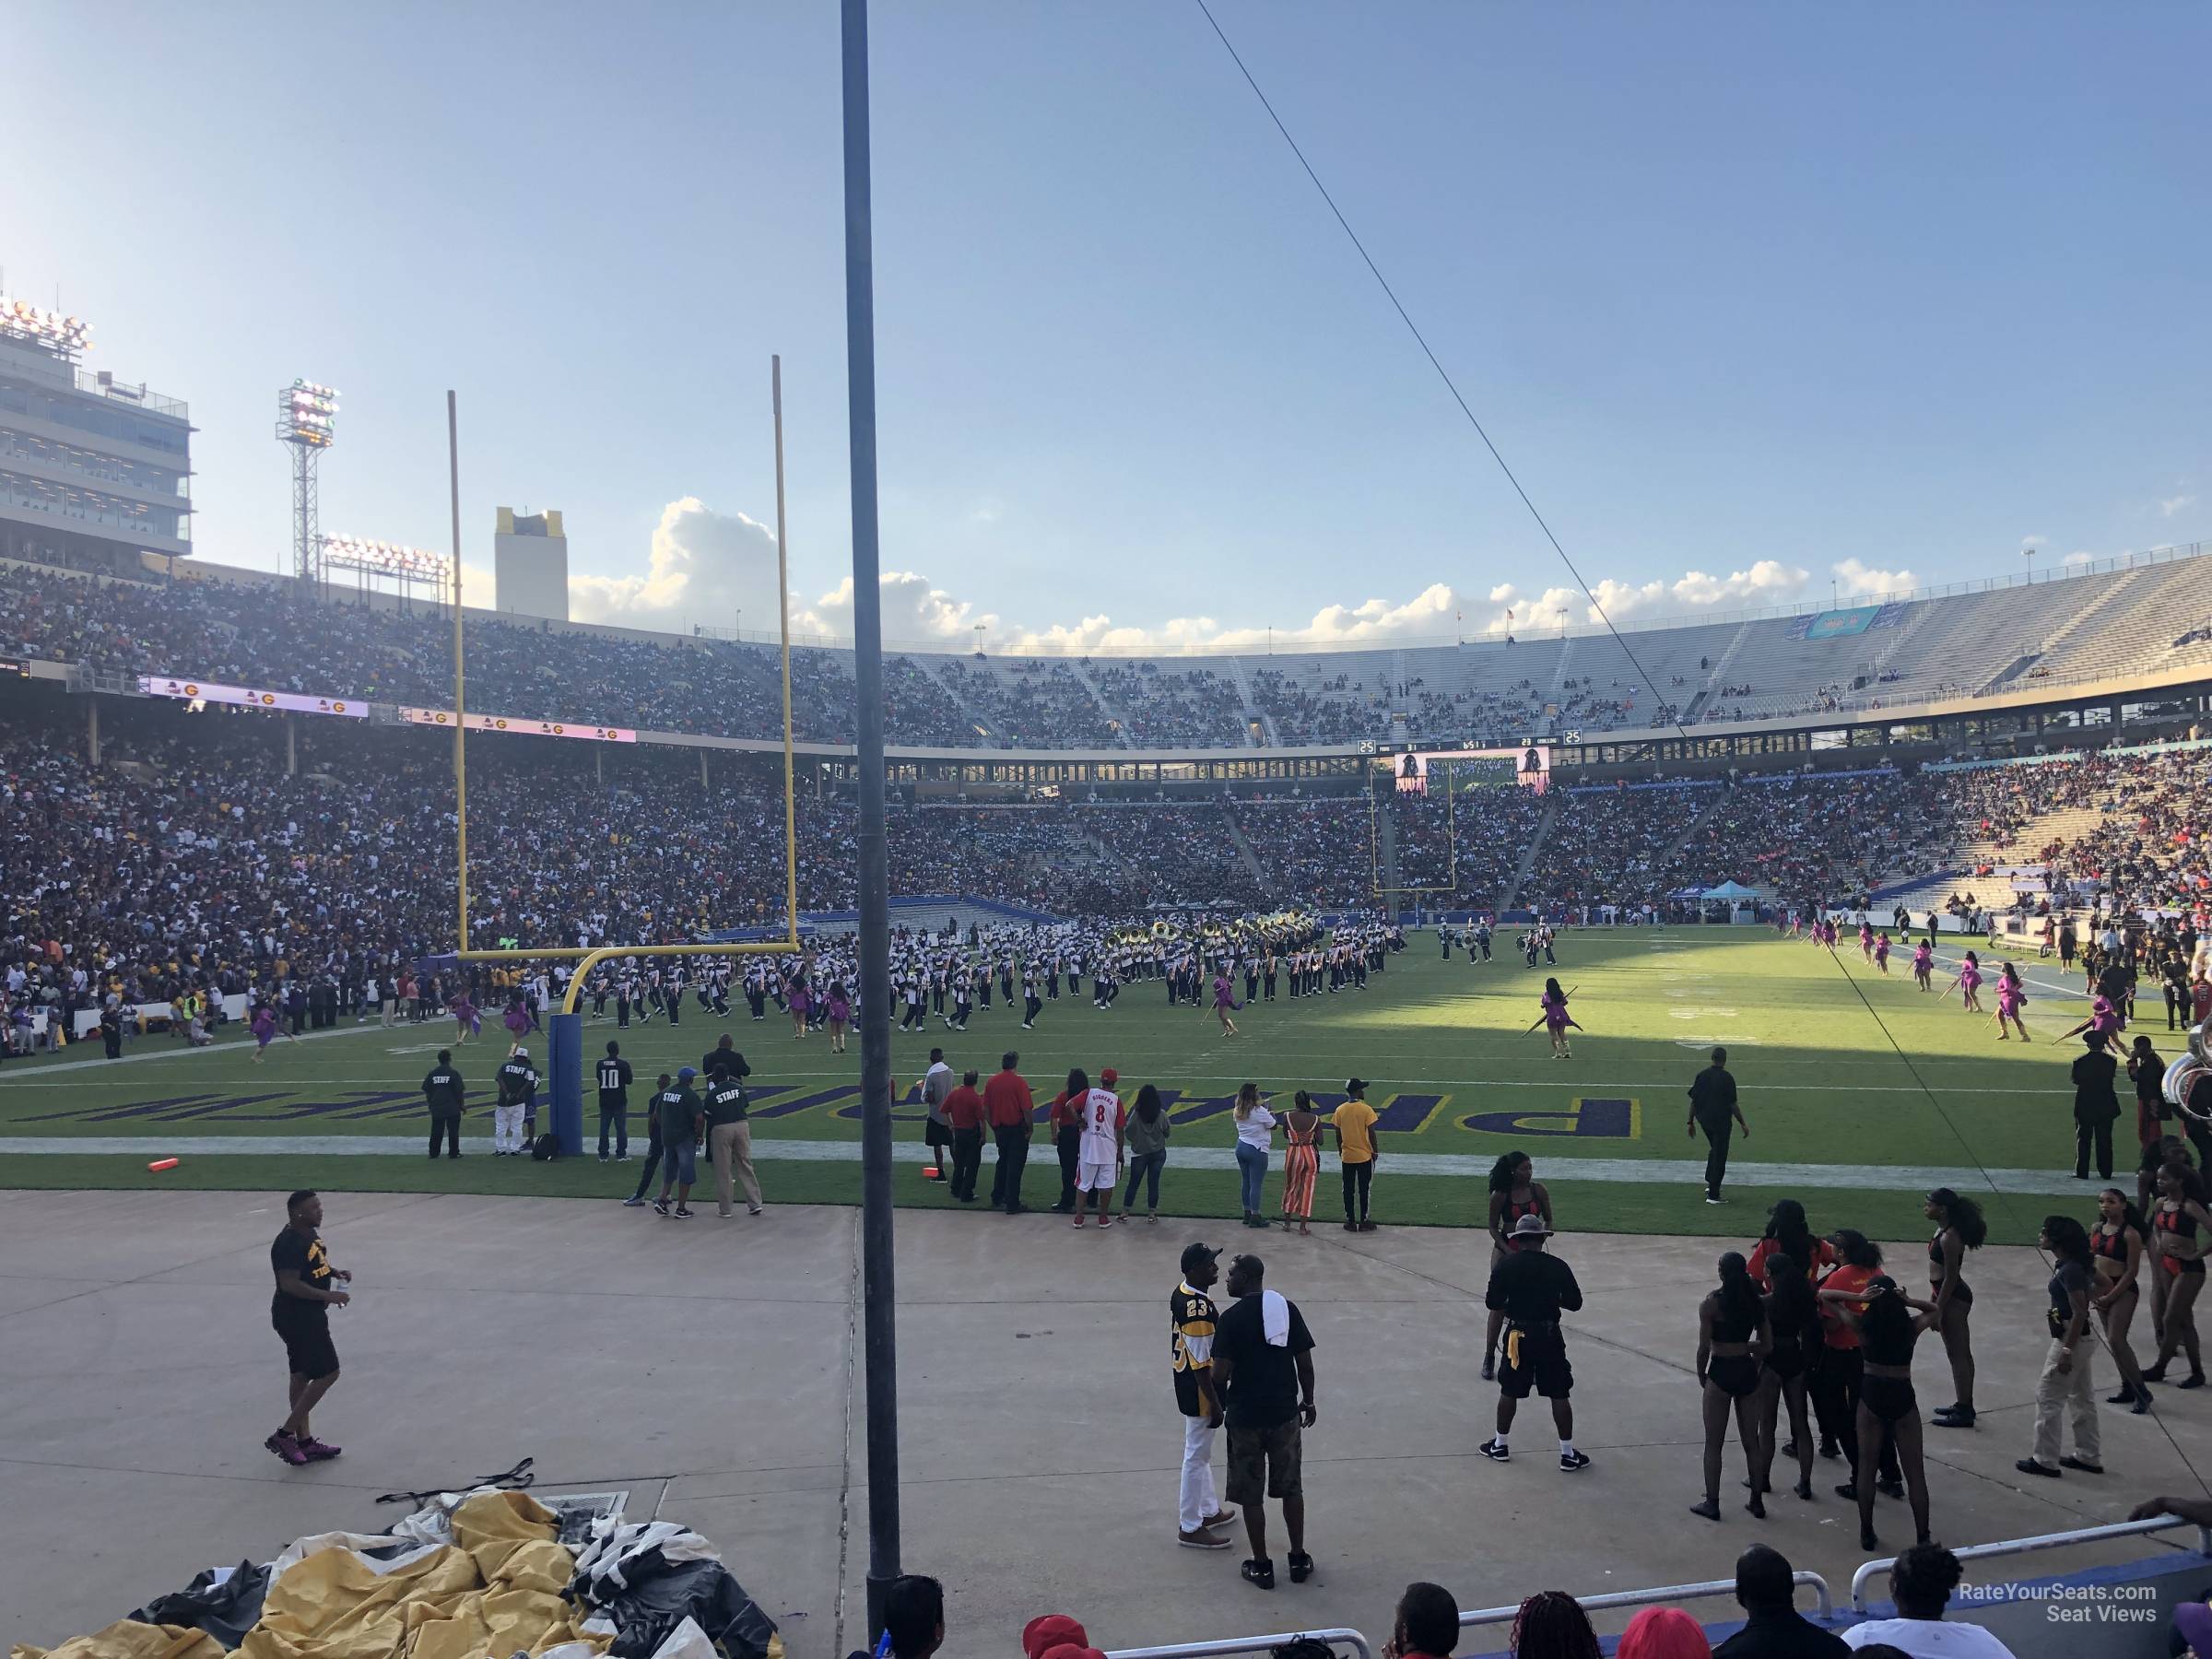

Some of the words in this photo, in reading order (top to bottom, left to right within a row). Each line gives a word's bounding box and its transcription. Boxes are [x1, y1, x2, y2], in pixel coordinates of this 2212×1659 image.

[1565, 731, 1581, 743] 25
[1359, 742, 1374, 753] 25
[505, 1065, 526, 1075] STAFF
[600, 1069, 619, 1089] 10
[663, 1092, 682, 1104] STAFF
[715, 1088, 741, 1104] STAFF
[1095, 1104, 1106, 1124] 8
[1186, 1299, 1207, 1318] 23
